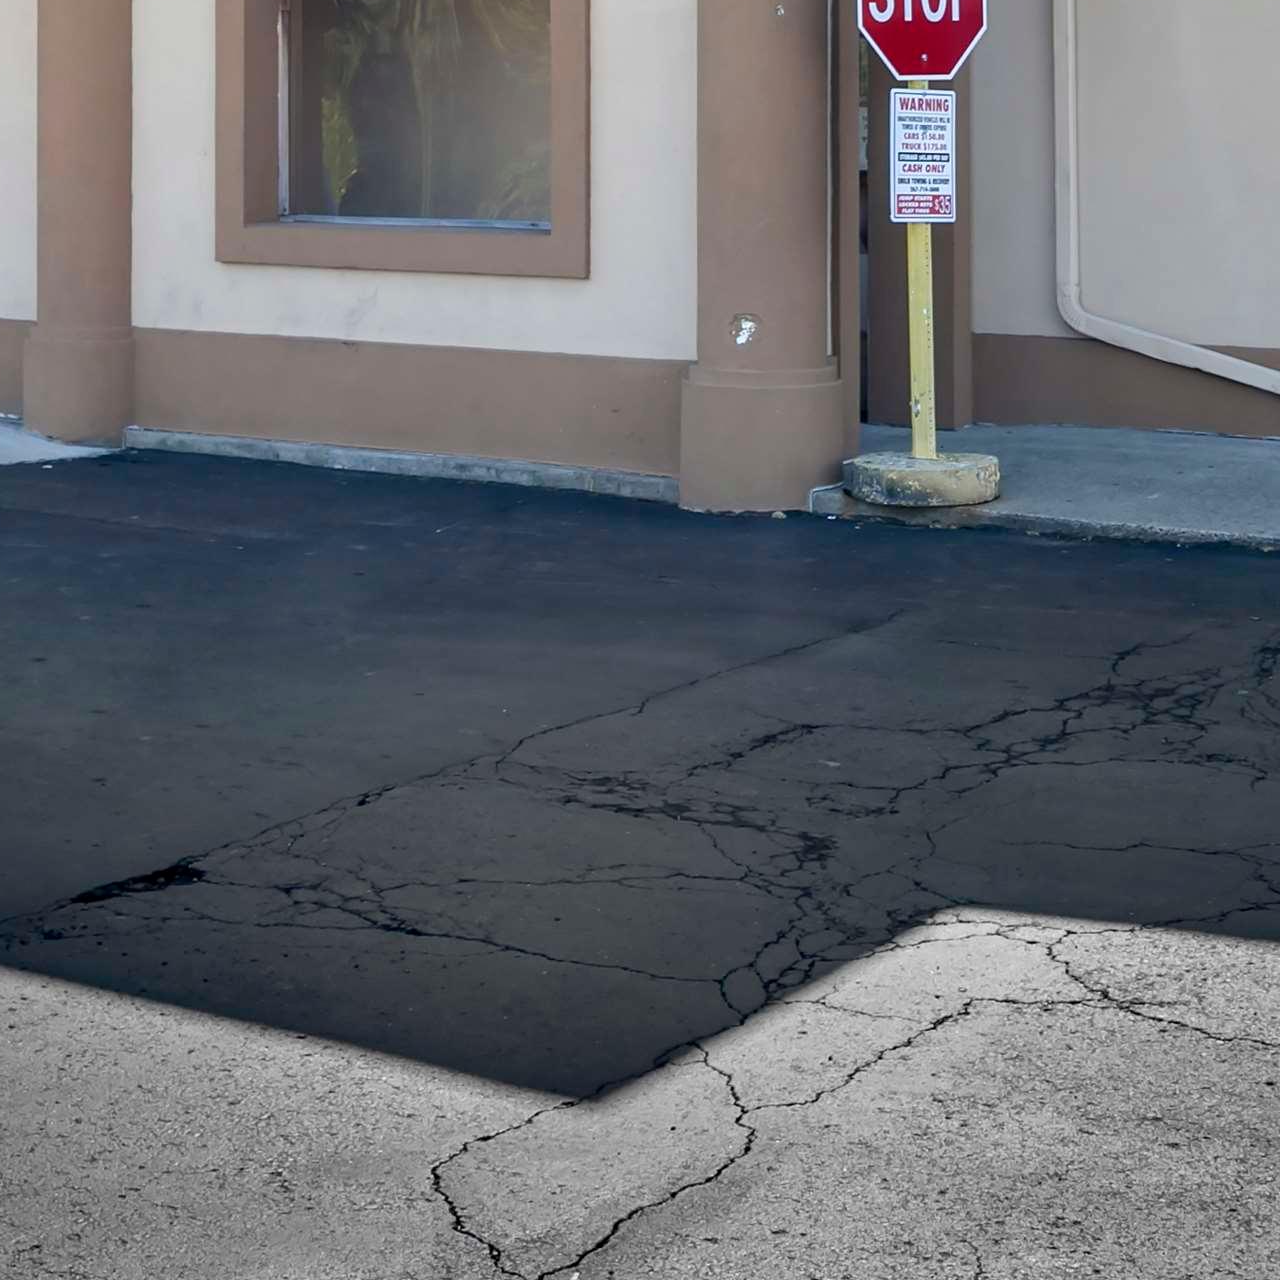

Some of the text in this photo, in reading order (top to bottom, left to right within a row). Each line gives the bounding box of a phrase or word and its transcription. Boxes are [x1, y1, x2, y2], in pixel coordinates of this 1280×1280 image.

[899, 96, 950, 112] WARNING
[902, 163, 946, 173] CASH ONLY
